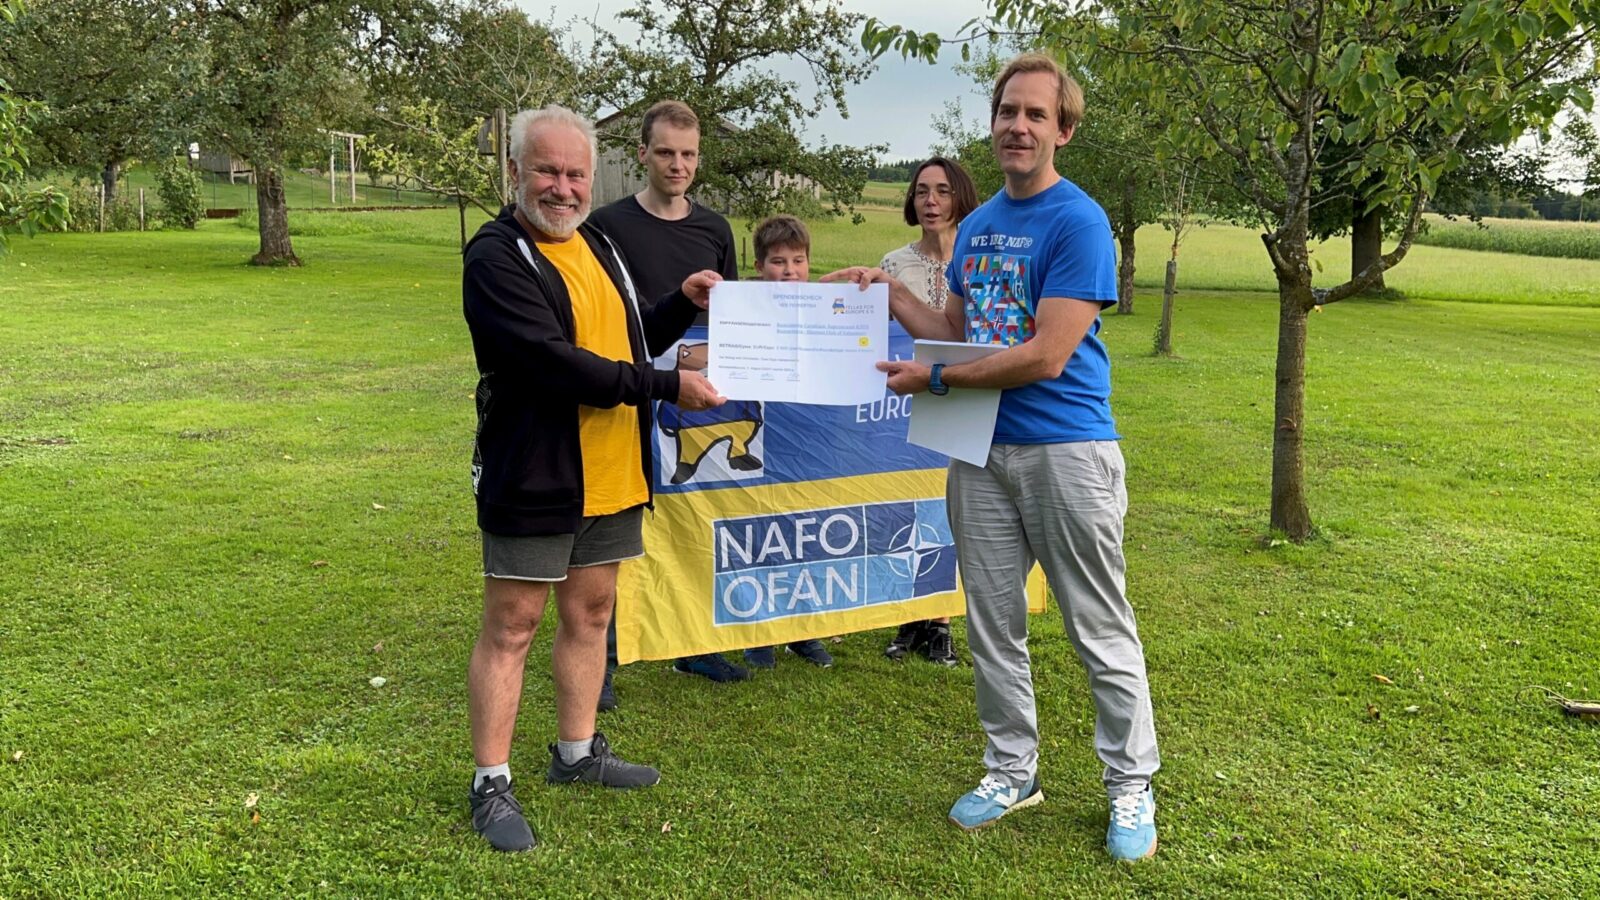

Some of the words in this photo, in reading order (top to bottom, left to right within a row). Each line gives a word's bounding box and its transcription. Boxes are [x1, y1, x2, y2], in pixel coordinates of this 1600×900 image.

[971, 235, 988, 247] WE
[856, 394, 913, 423] EURO
[719, 513, 859, 568] NAFO
[723, 563, 858, 618] OFAN
